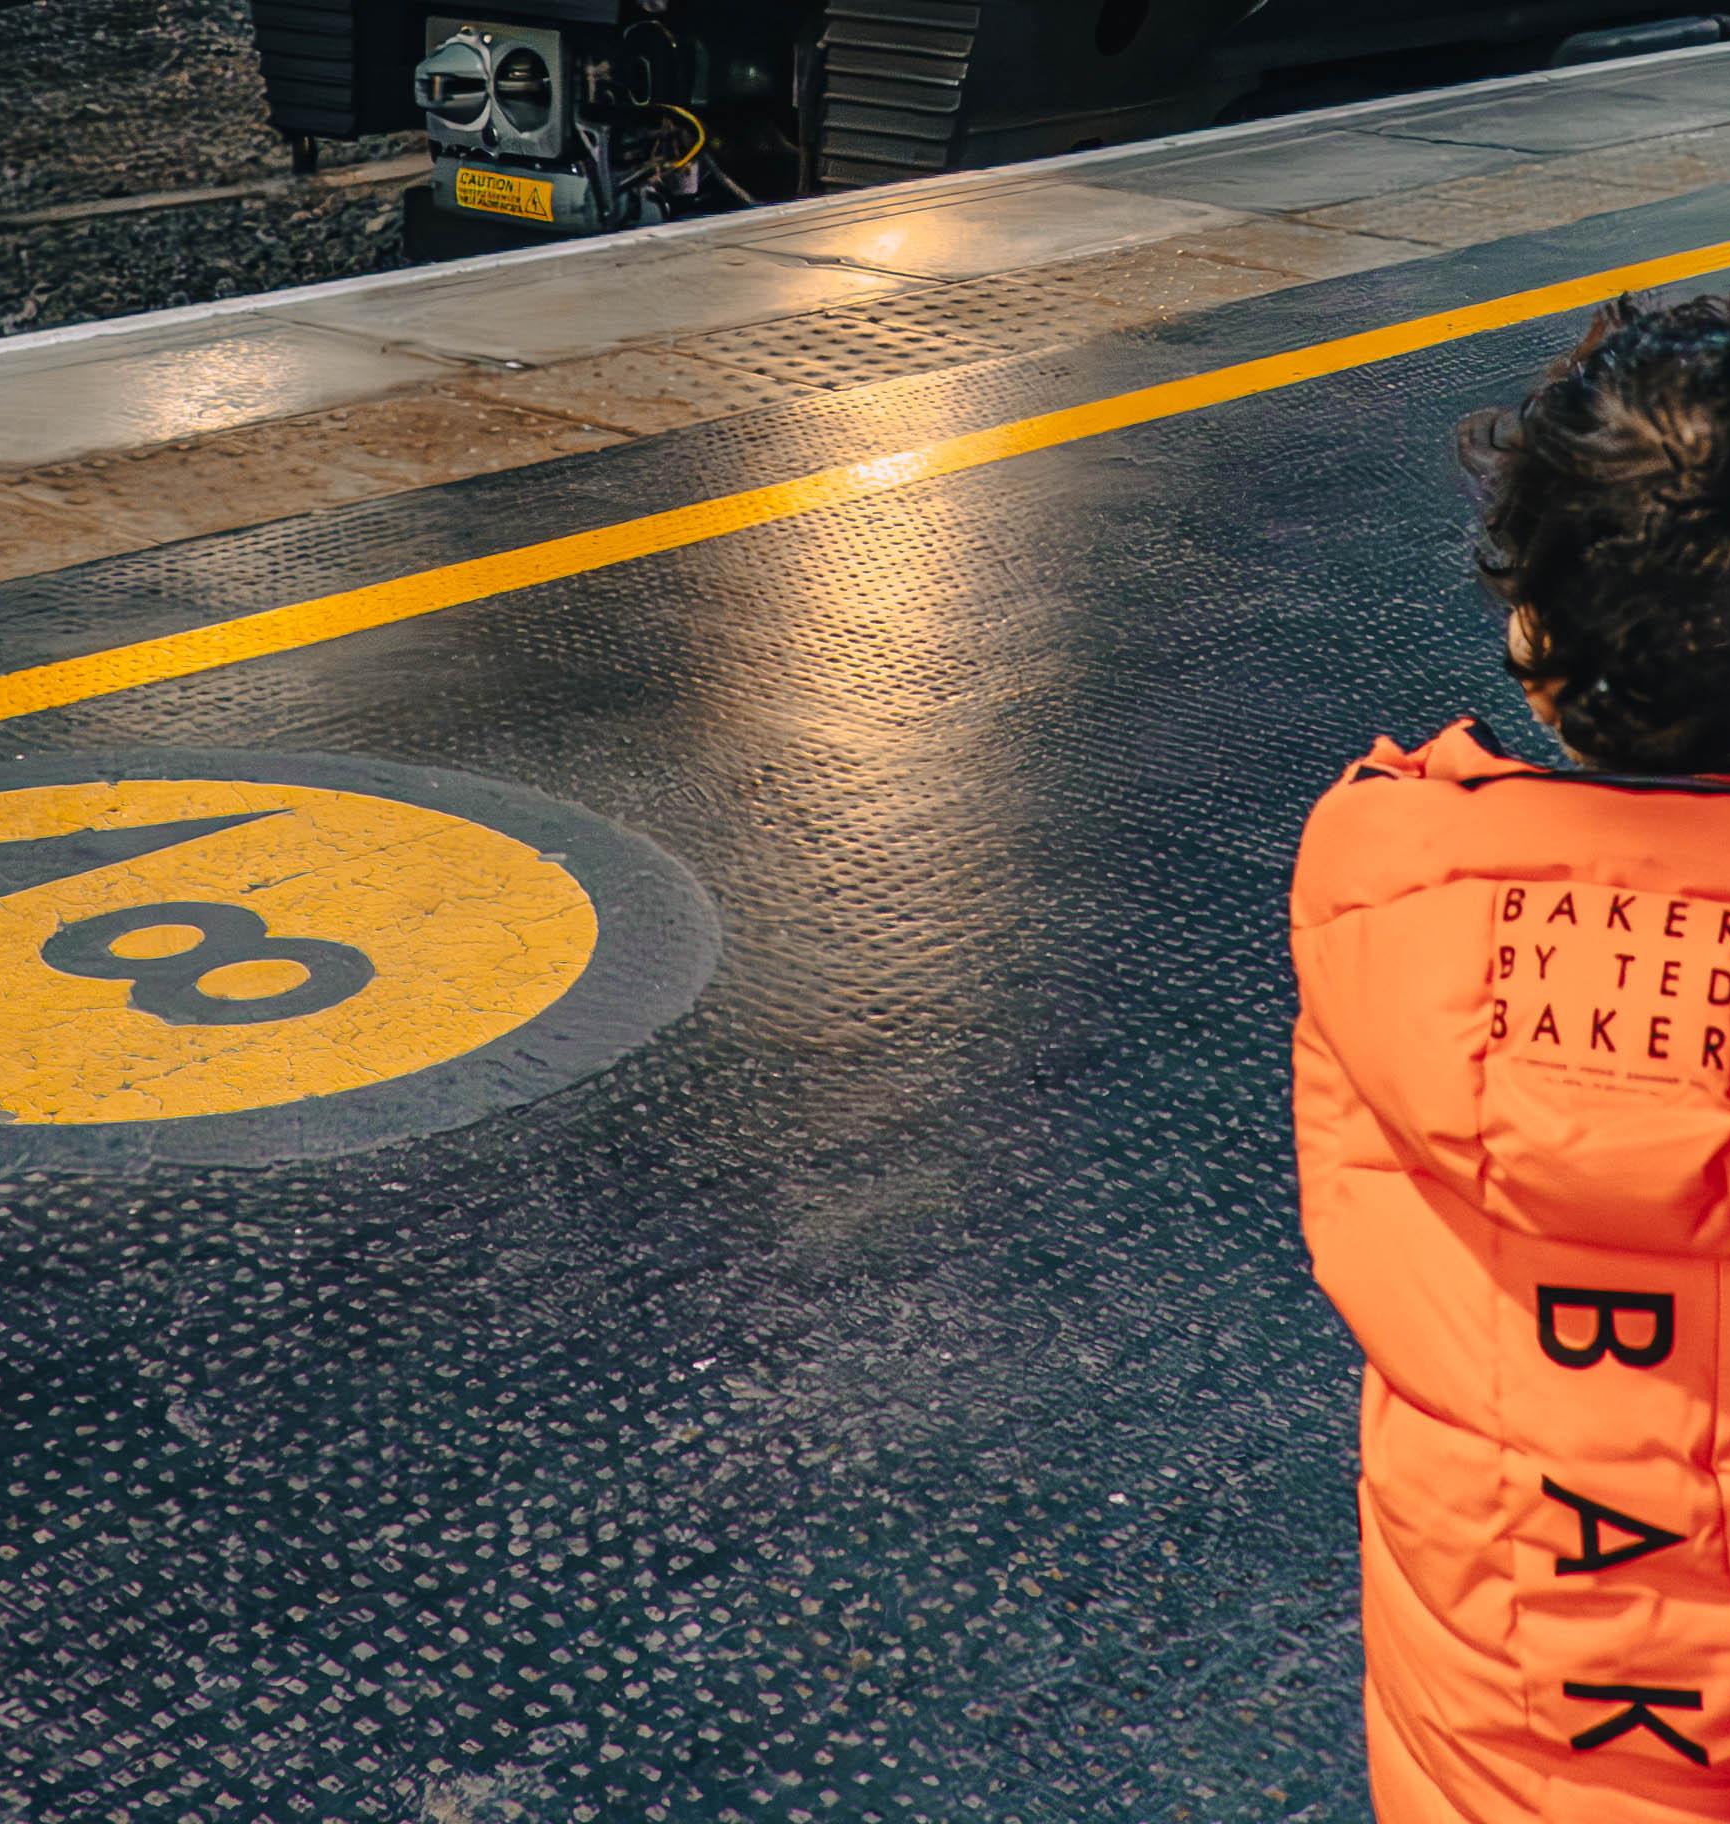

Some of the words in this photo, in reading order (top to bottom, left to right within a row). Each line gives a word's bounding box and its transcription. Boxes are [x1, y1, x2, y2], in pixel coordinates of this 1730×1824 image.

[461, 172, 513, 192] CAUTION
[39, 901, 376, 1027] 8
[1499, 945, 1557, 980] BY
[1490, 999, 1726, 1071] BAKER
